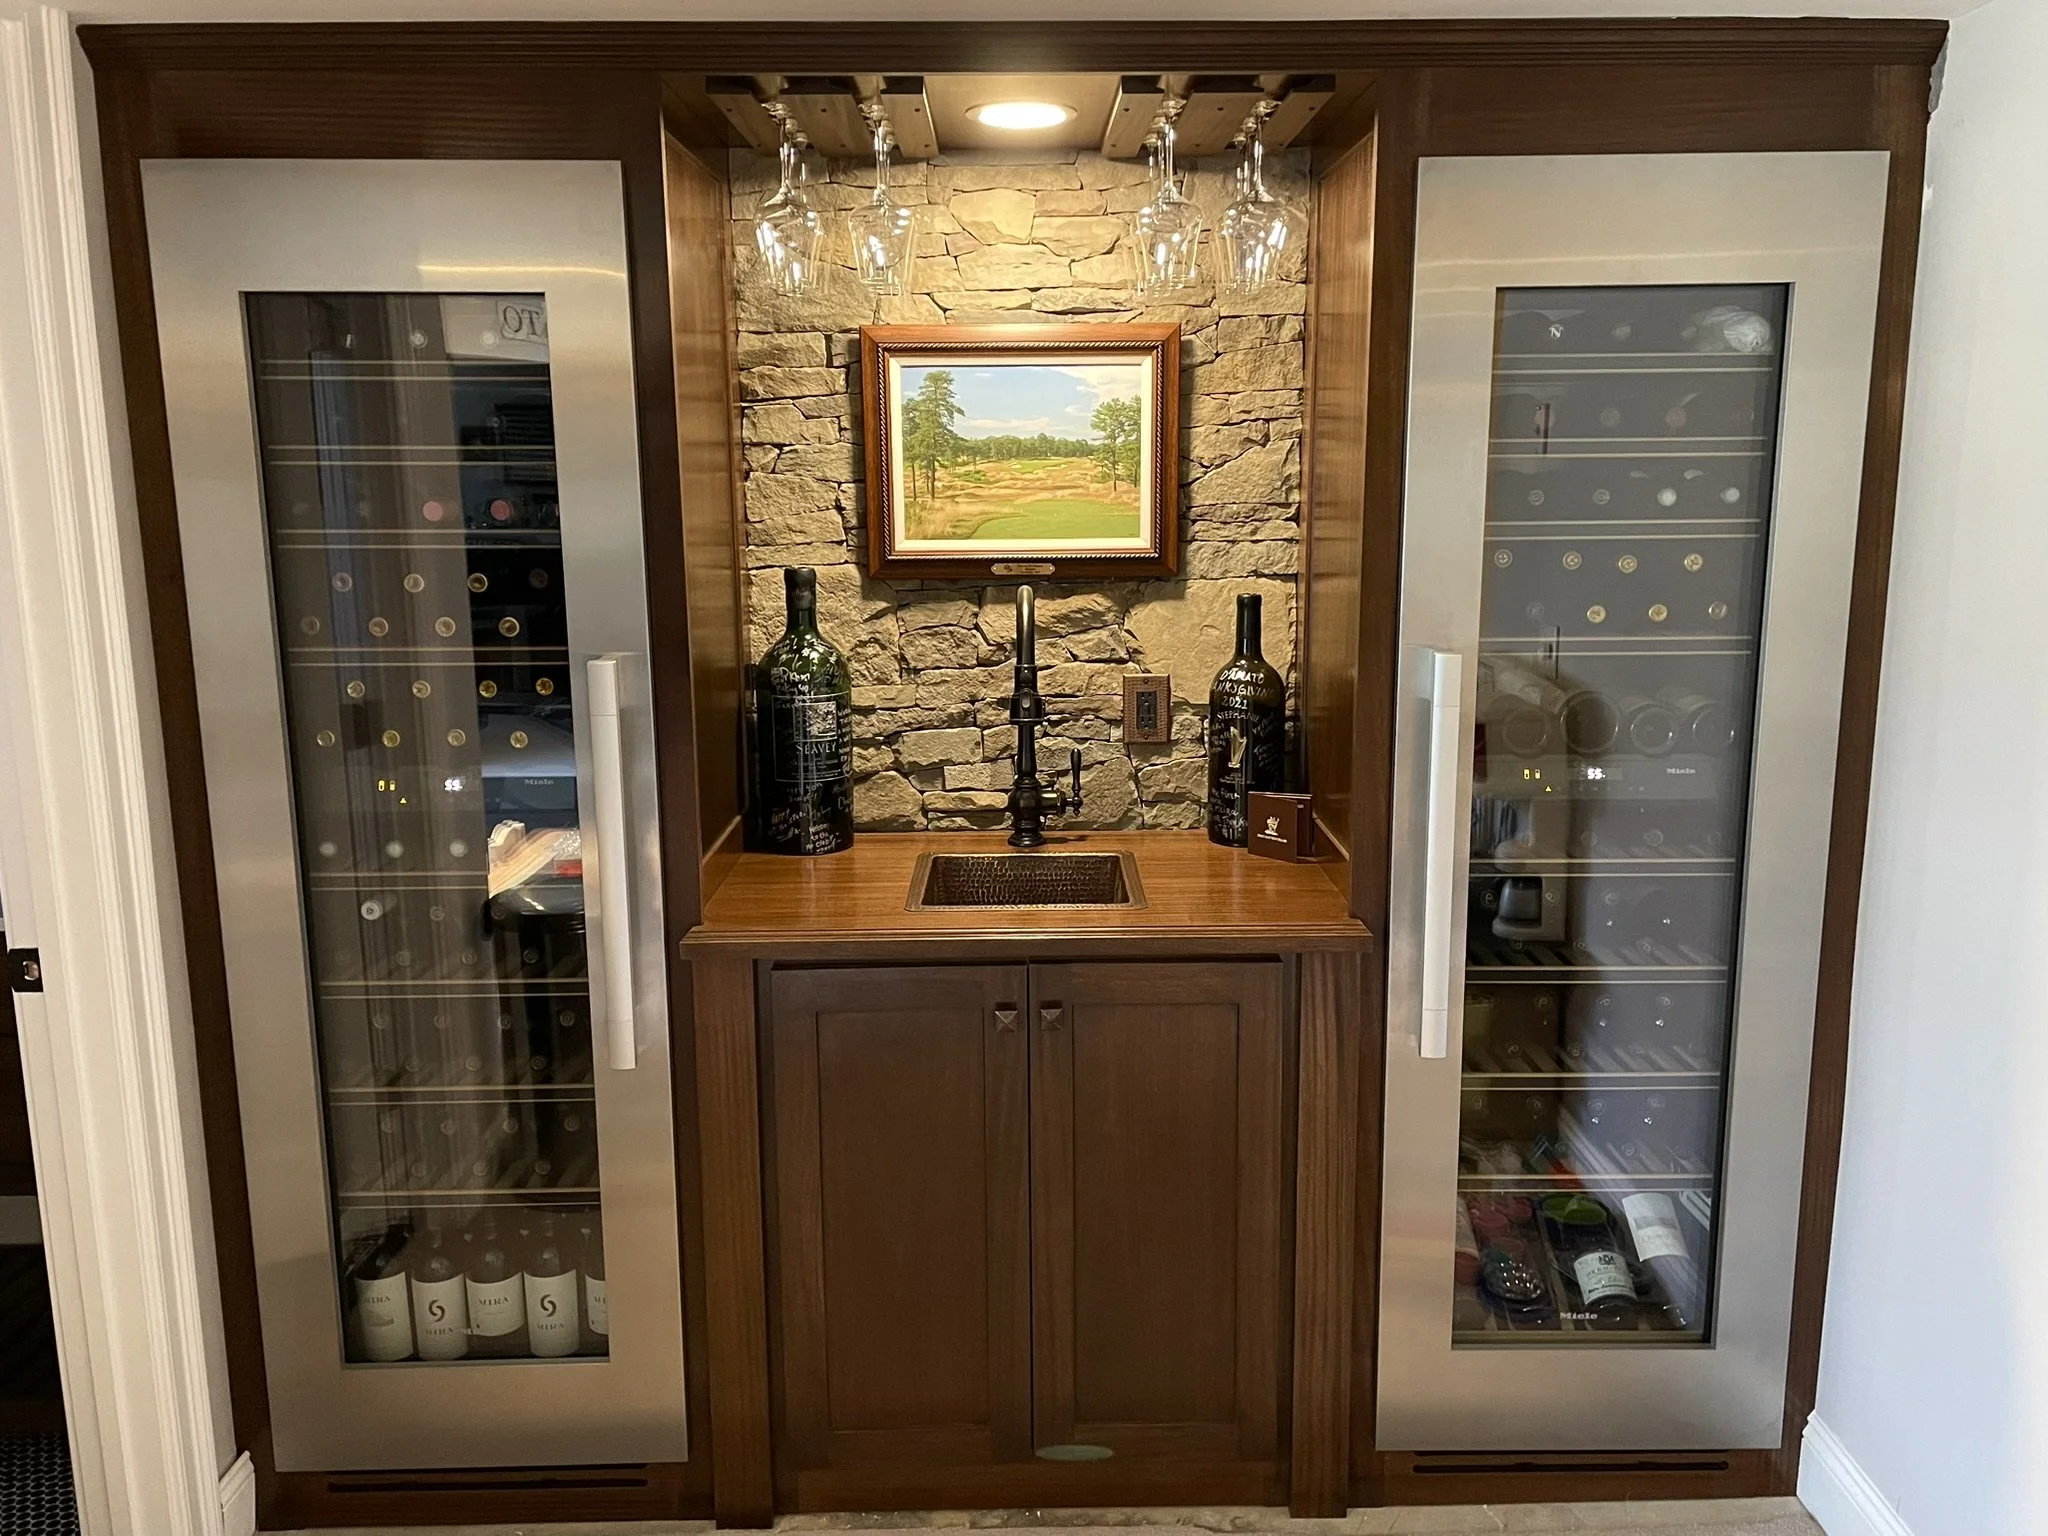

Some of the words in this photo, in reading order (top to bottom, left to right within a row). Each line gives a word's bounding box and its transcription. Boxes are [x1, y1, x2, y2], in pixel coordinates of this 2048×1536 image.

[1221, 696, 1248, 709] 2021
[795, 741, 837, 756] SEAVEY
[478, 1296, 510, 1307] MIRA
[1560, 1311, 1598, 1321] Miele
[536, 1322, 565, 1332] MIRA
